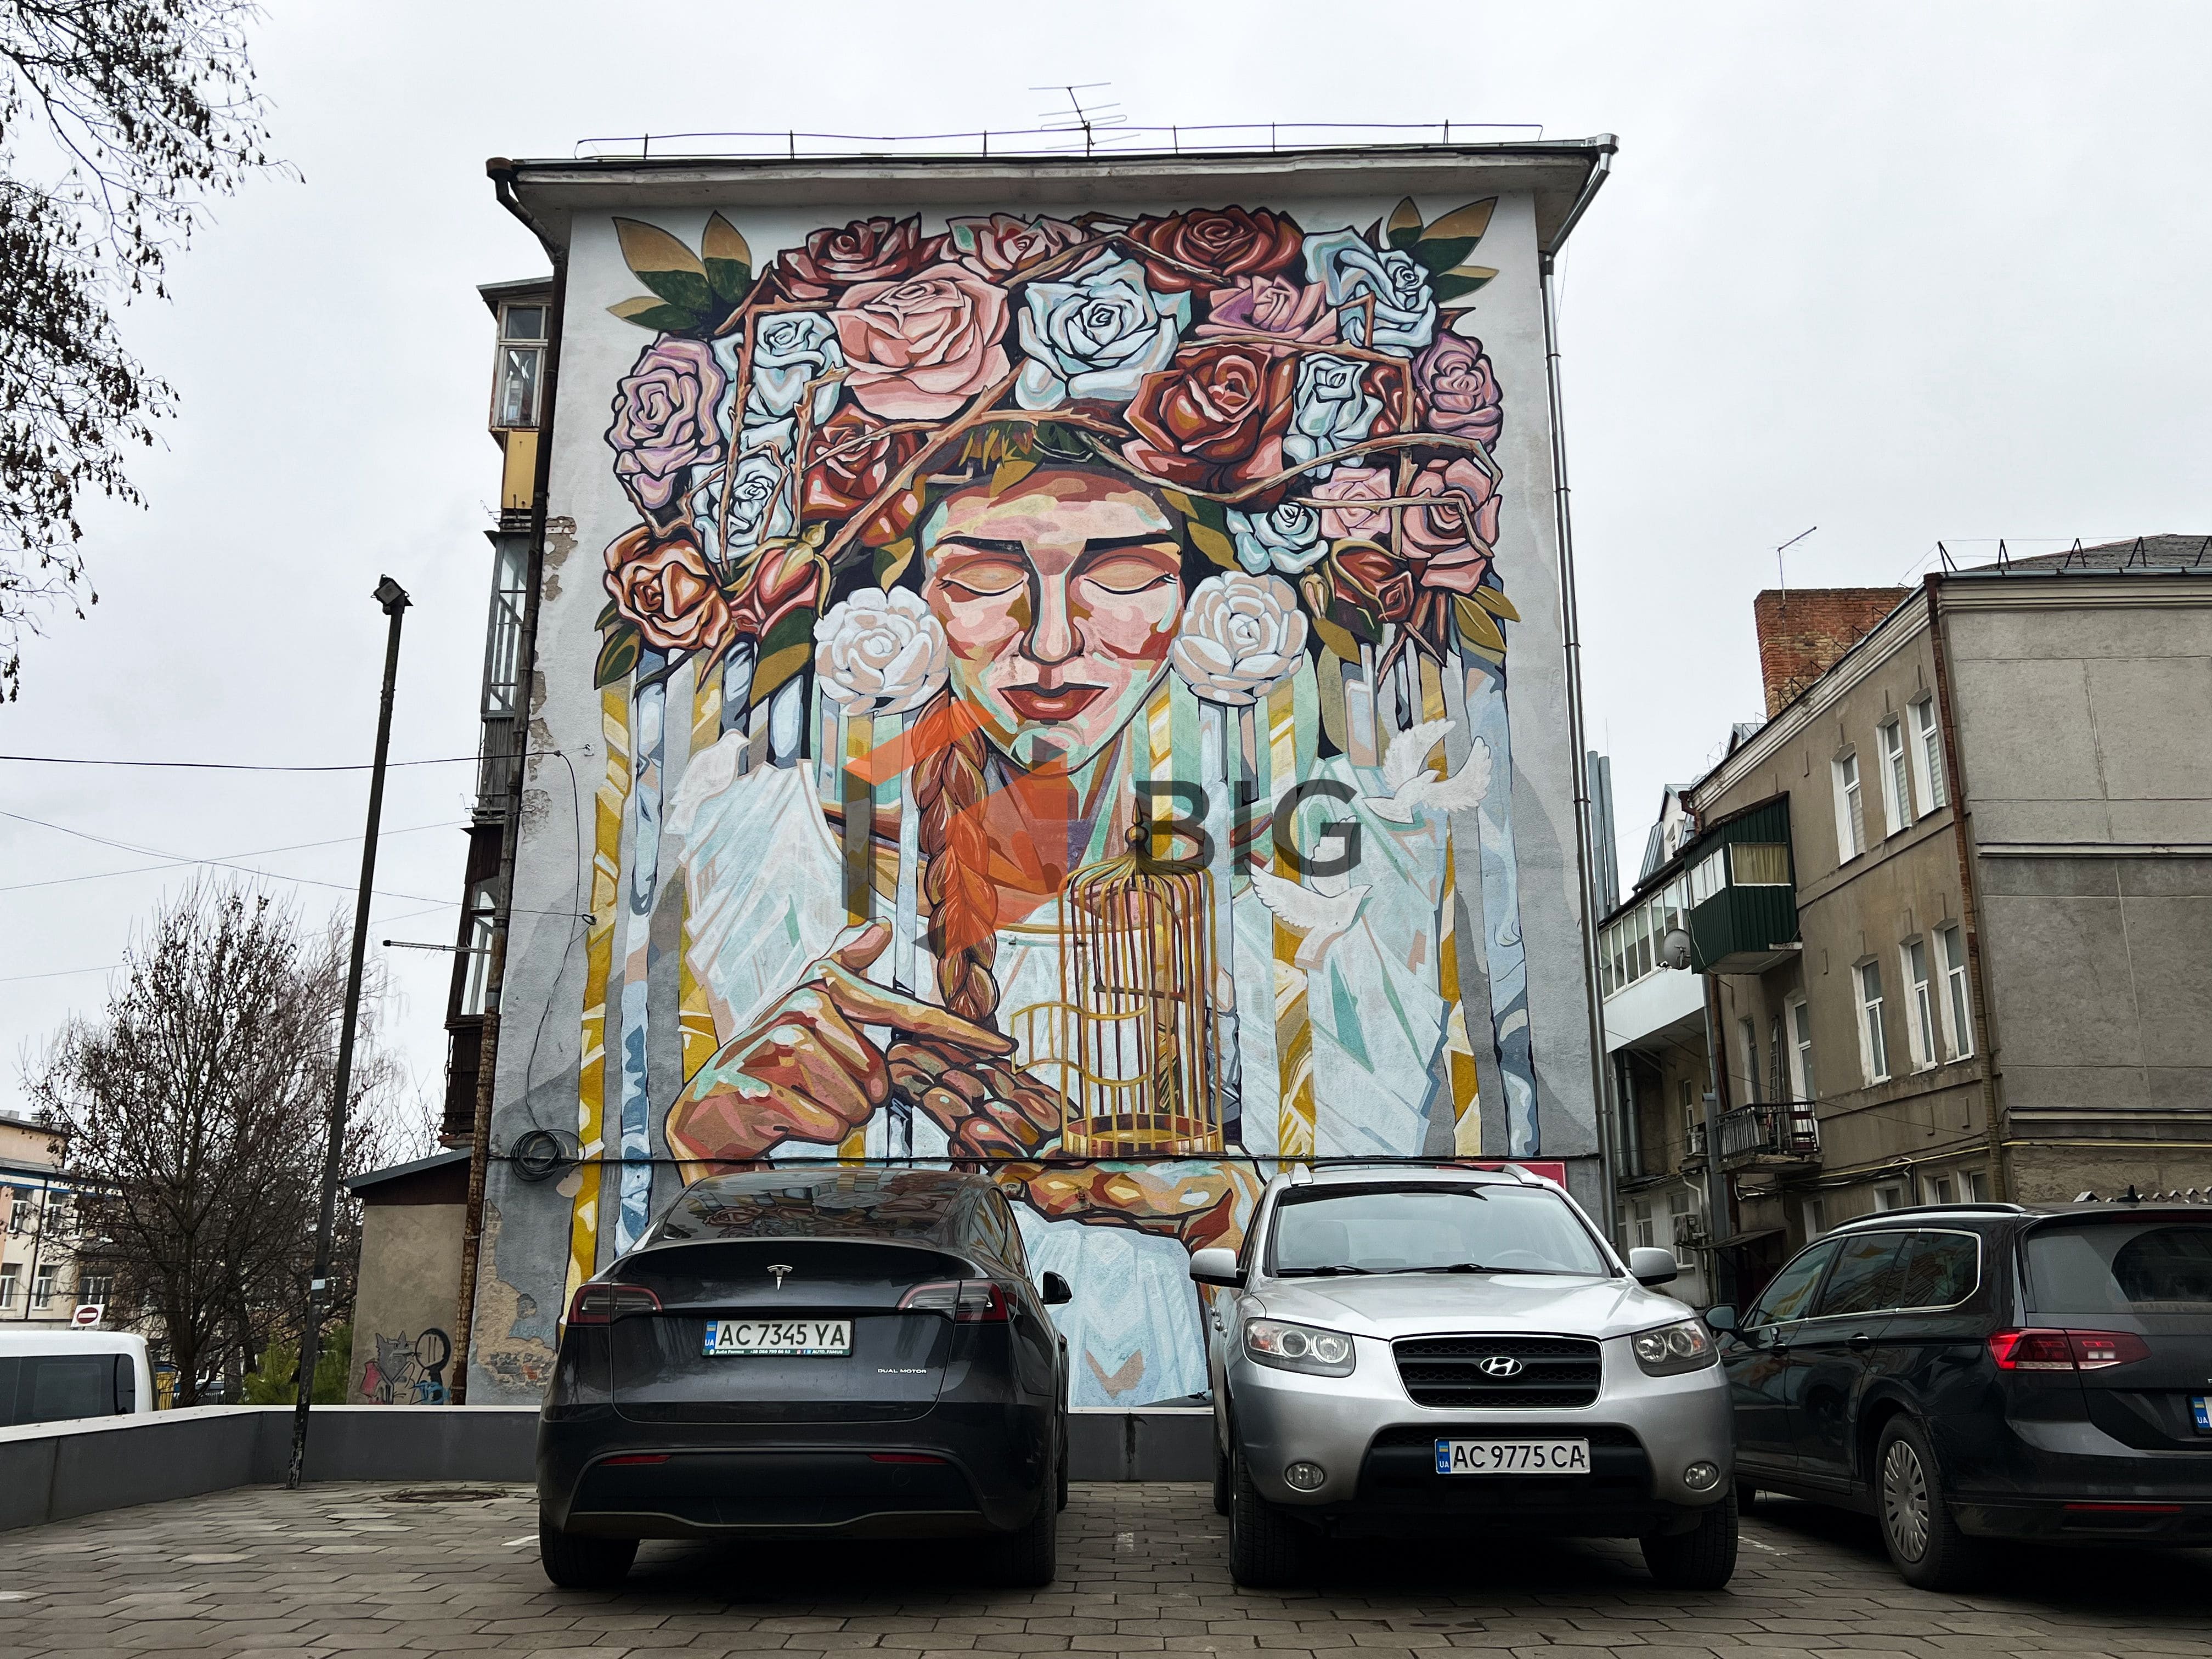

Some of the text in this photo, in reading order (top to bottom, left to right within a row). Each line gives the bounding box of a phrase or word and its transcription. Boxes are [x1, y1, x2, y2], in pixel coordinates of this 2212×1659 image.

[719, 1324, 845, 1346] AC 7345 YA
[1454, 1445, 1585, 1468] AC 9775 CA
